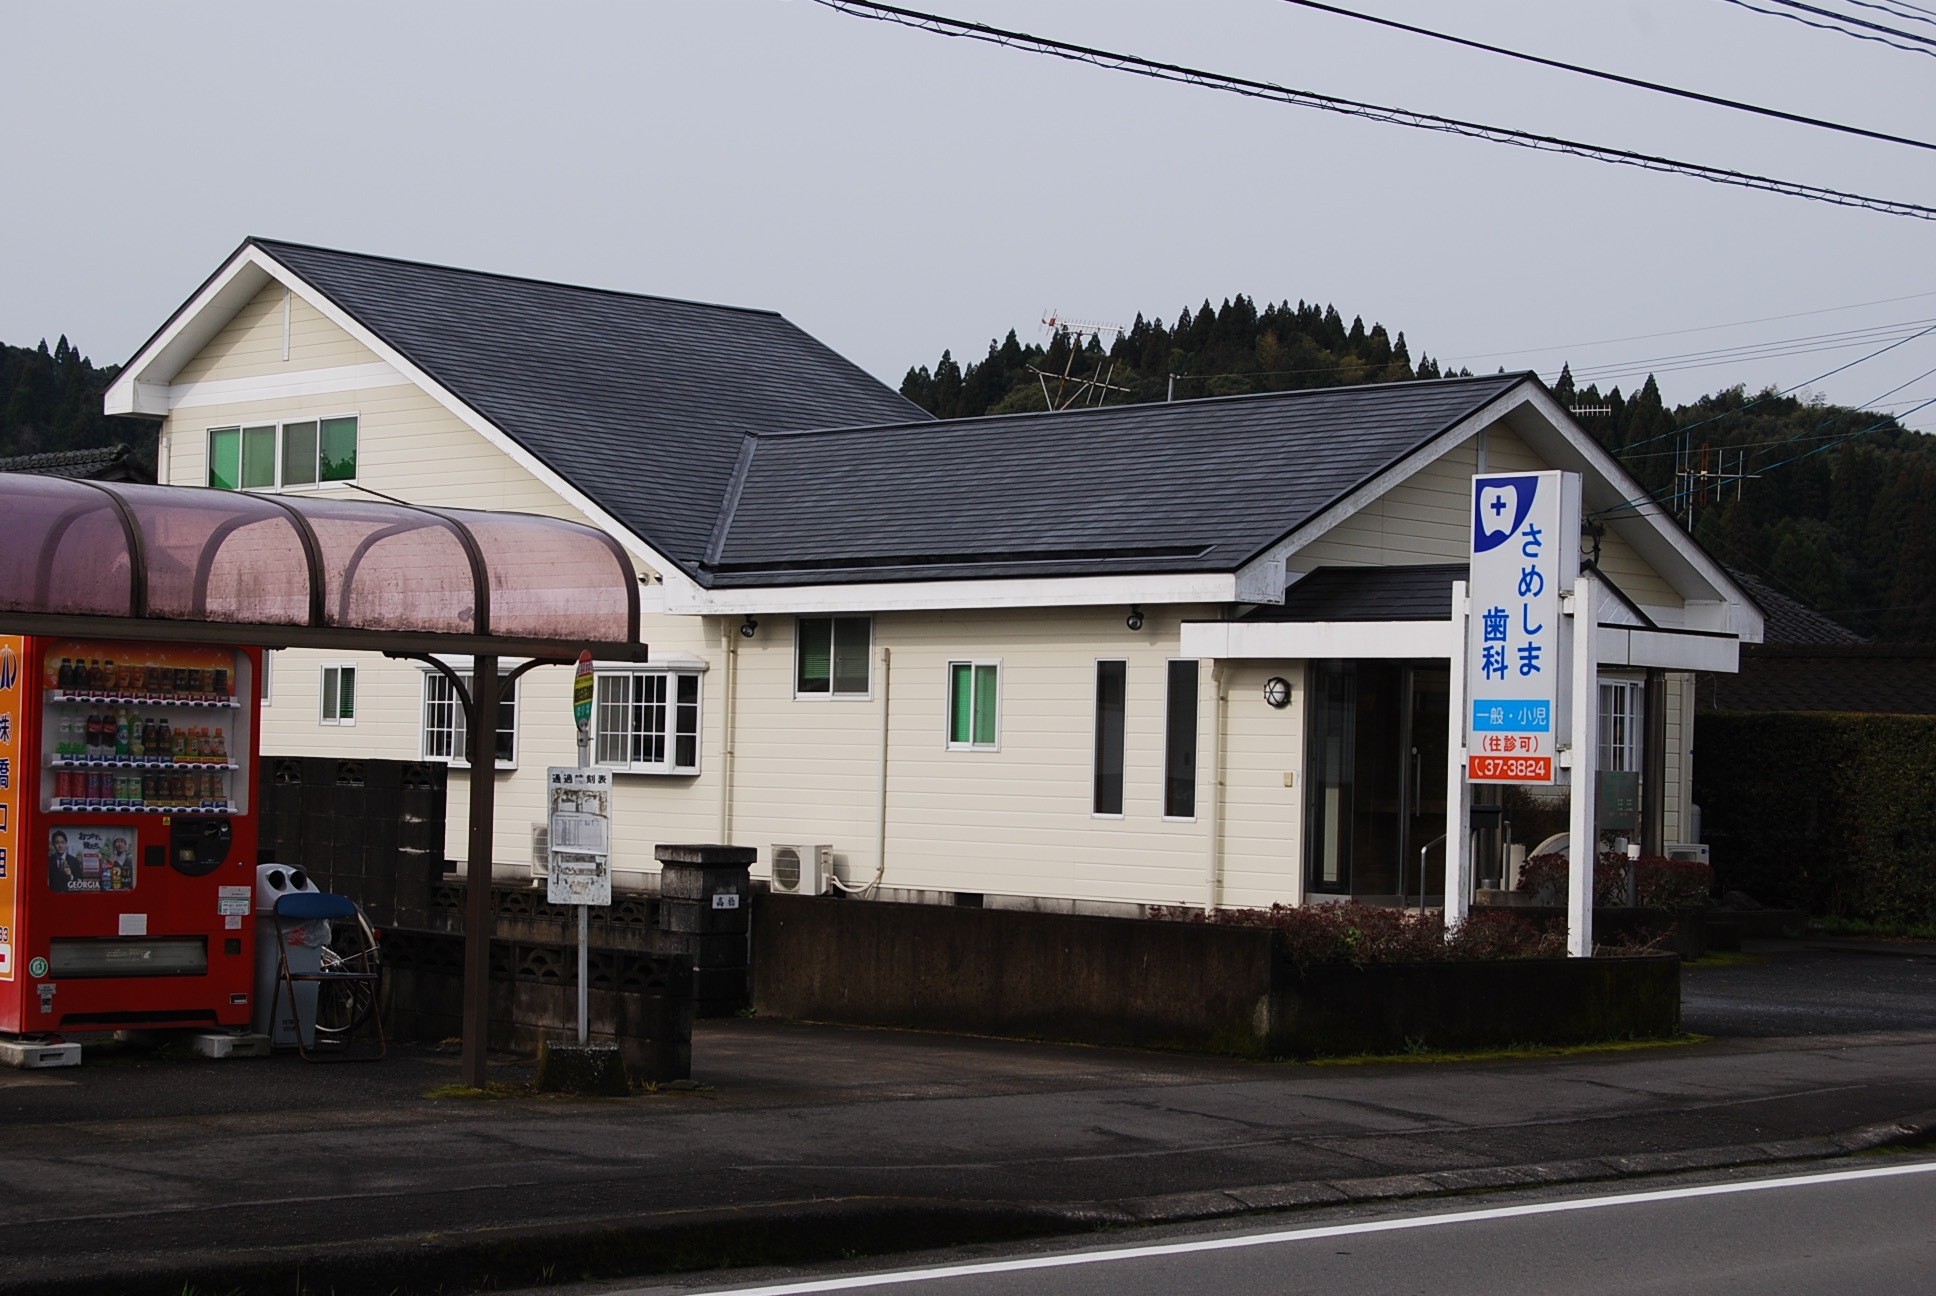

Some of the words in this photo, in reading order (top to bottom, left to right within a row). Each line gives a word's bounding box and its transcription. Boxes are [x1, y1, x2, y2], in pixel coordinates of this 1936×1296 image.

[1517, 523, 1544, 677] さめしま
[1481, 606, 1509, 681] 歯科
[1476, 706, 1547, 725] 一般・小児
[1482, 734, 1539, 753] (往診可)
[1484, 759, 1546, 776] 37-3824
[67, 881, 100, 889] GEORGIA
